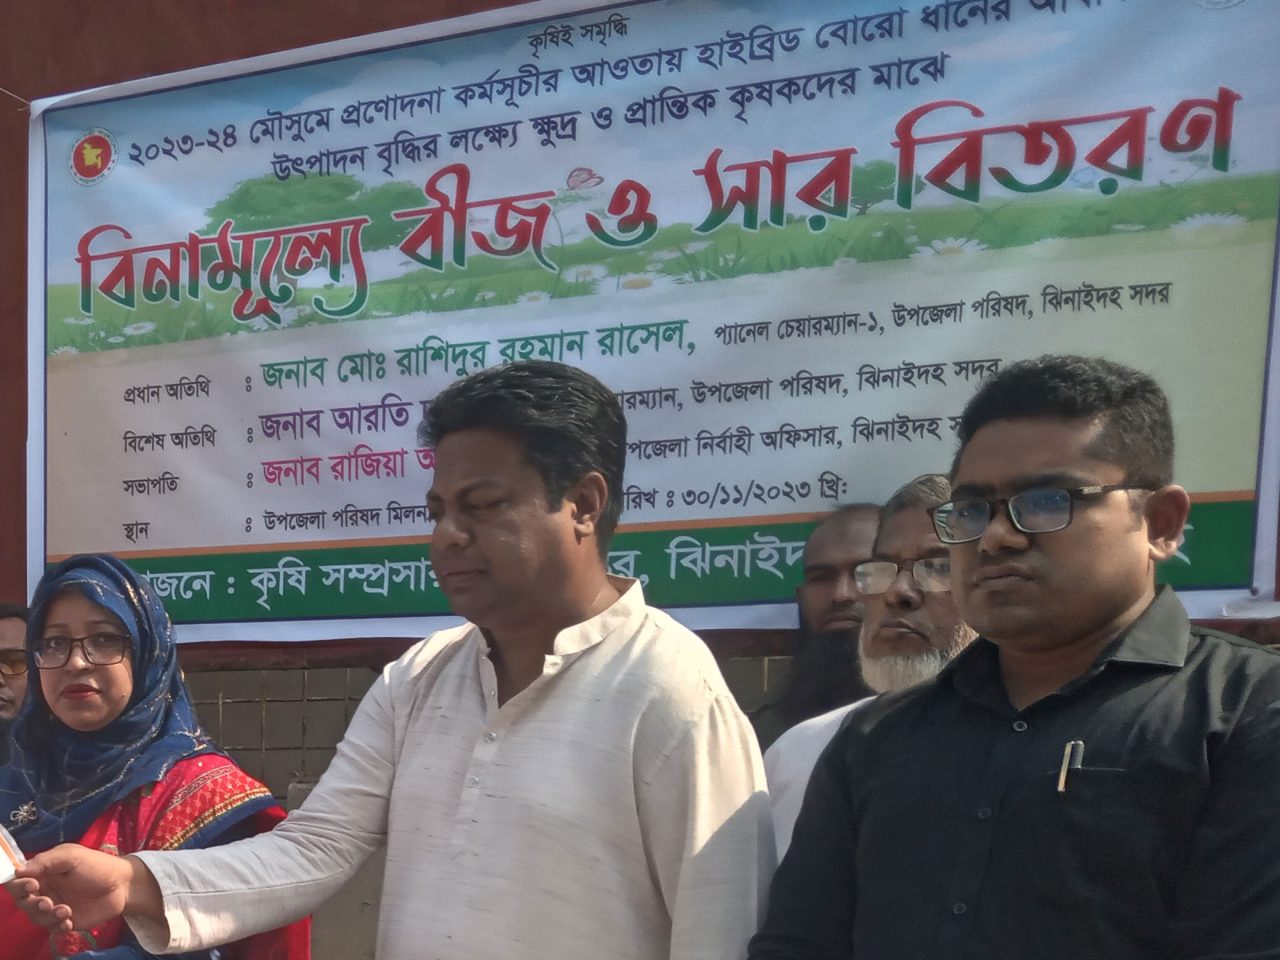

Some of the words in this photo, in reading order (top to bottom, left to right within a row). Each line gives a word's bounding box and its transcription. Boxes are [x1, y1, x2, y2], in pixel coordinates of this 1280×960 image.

[581, 13, 630, 47] সমৃদ্ধি
[128, 124, 237, 167] ২০২৩-২৪
[249, 107, 333, 143] মৌসুমে
[341, 86, 446, 128] প্রণোদনা
[452, 64, 563, 109] কর্মসূচীর
[570, 47, 688, 87] আওতায়
[695, 24, 805, 70] হাইব্রিড
[816, 7, 909, 49] বোরো
[920, 0, 1011, 33] ধানের
[270, 145, 368, 182] উৎপাদন
[374, 130, 442, 177] বৃদ্ধির
[448, 120, 522, 154] লক্ষ্যে
[529, 110, 582, 148] ক্ষুদ্র
[591, 106, 612, 129] ও
[624, 86, 719, 127] প্রান্তিক
[726, 67, 861, 124] কৃষকদের
[869, 50, 951, 89] মাঝে
[74, 223, 370, 325] বিনামূল্যে
[394, 162, 559, 273] বীজ
[586, 178, 658, 248] ও
[691, 146, 859, 236] সার
[891, 86, 1244, 211] বিতরণ
[123, 385, 161, 404] প্রধান
[165, 374, 211, 401] অতিথি
[260, 356, 328, 389] জনাব
[337, 349, 386, 383] মোঃ
[394, 335, 491, 377] রাশিদুর
[498, 328, 589, 364] রহমান
[596, 319, 696, 356] রাসেল,
[714, 321, 771, 346] প্যানেল
[891, 299, 965, 327] উপজেলা
[971, 290, 1033, 319] পরিষদ,
[1040, 282, 1123, 314] ঝিনাইদহ
[1128, 282, 1173, 305] সদর
[616, 387, 683, 411] ারম্যান,
[690, 377, 772, 404] উপজেলা
[779, 370, 848, 397] পরিষদ,
[856, 360, 946, 391] ঝিনাইদহ
[123, 431, 164, 453] বিশেষ
[171, 424, 217, 450] অতিথি
[259, 408, 325, 441] জনাব
[331, 392, 413, 435] আরতি
[626, 435, 691, 460] পজেলা
[696, 426, 754, 456] নির্বাহী
[760, 423, 843, 450] অফিসার,
[852, 414, 942, 443] ঝিনাইদহ
[123, 472, 179, 496] সভাপতি
[261, 456, 322, 486] জনাব
[330, 443, 408, 481] রাজিয়া
[623, 485, 659, 510] রিখ
[682, 479, 811, 509] ৩০/১১/২০২৩
[123, 520, 150, 543] স্থান
[263, 508, 325, 532] উপজেলা
[332, 503, 382, 529] পরিষদ
[386, 501, 431, 525] মিলন
[145, 570, 215, 600] জনে
[246, 556, 311, 611] কৃষি
